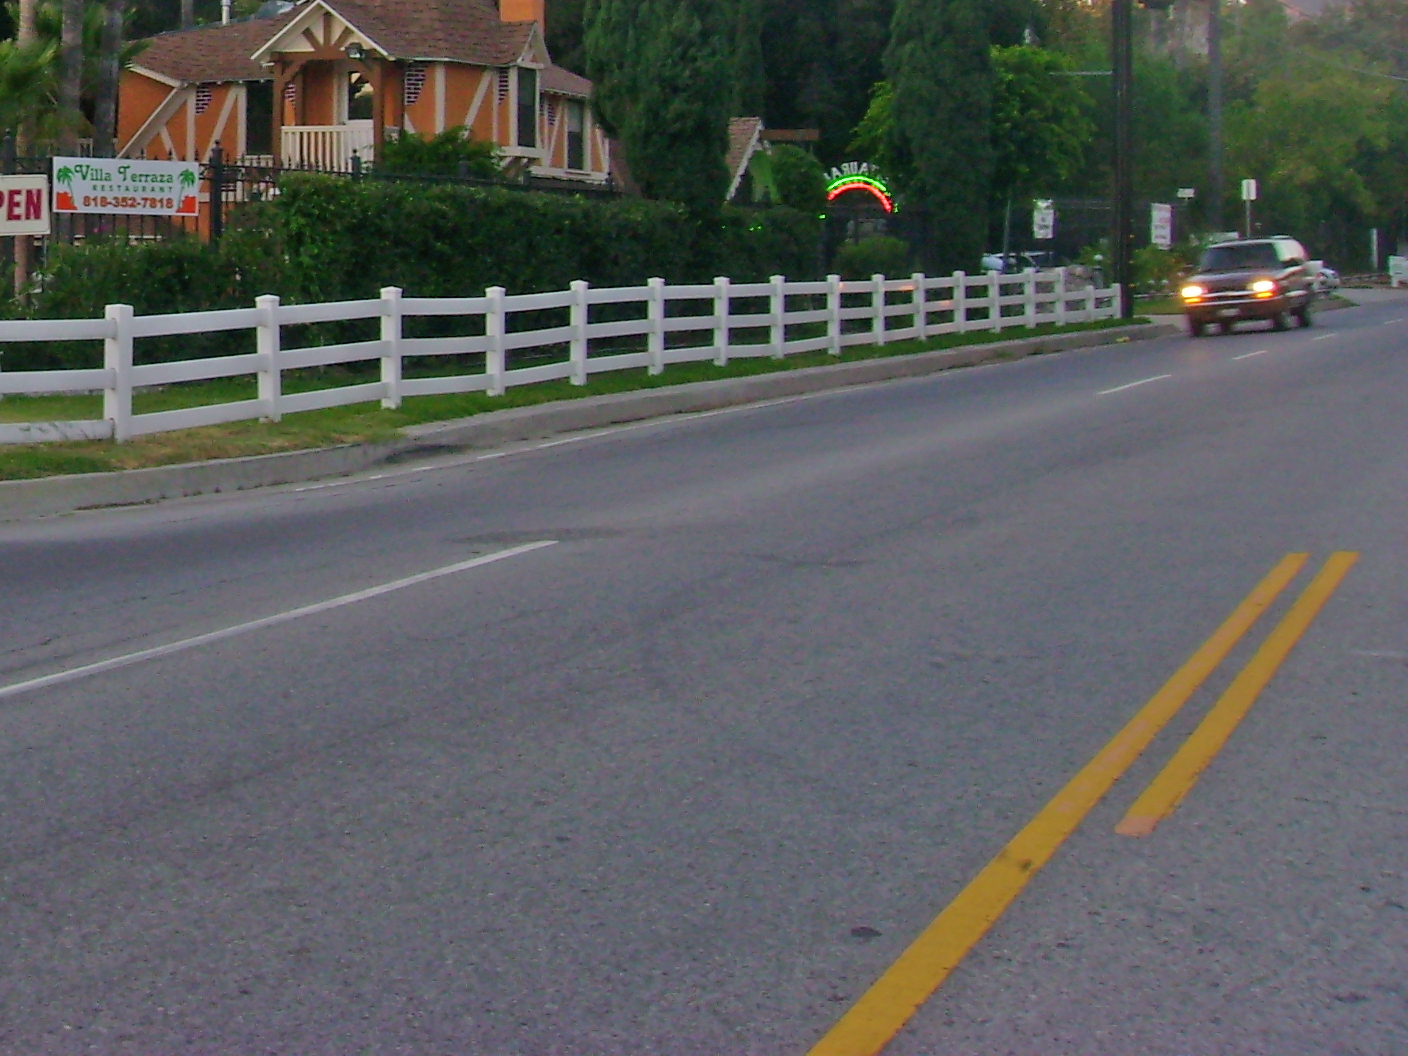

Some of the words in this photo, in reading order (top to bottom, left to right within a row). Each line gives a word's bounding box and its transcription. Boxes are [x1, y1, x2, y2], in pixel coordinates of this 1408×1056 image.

[74, 164, 112, 182] Villa
[117, 165, 174, 183] Terraza
[92, 184, 173, 193] RESTAURANT
[82, 196, 174, 209] 818-352-7818
